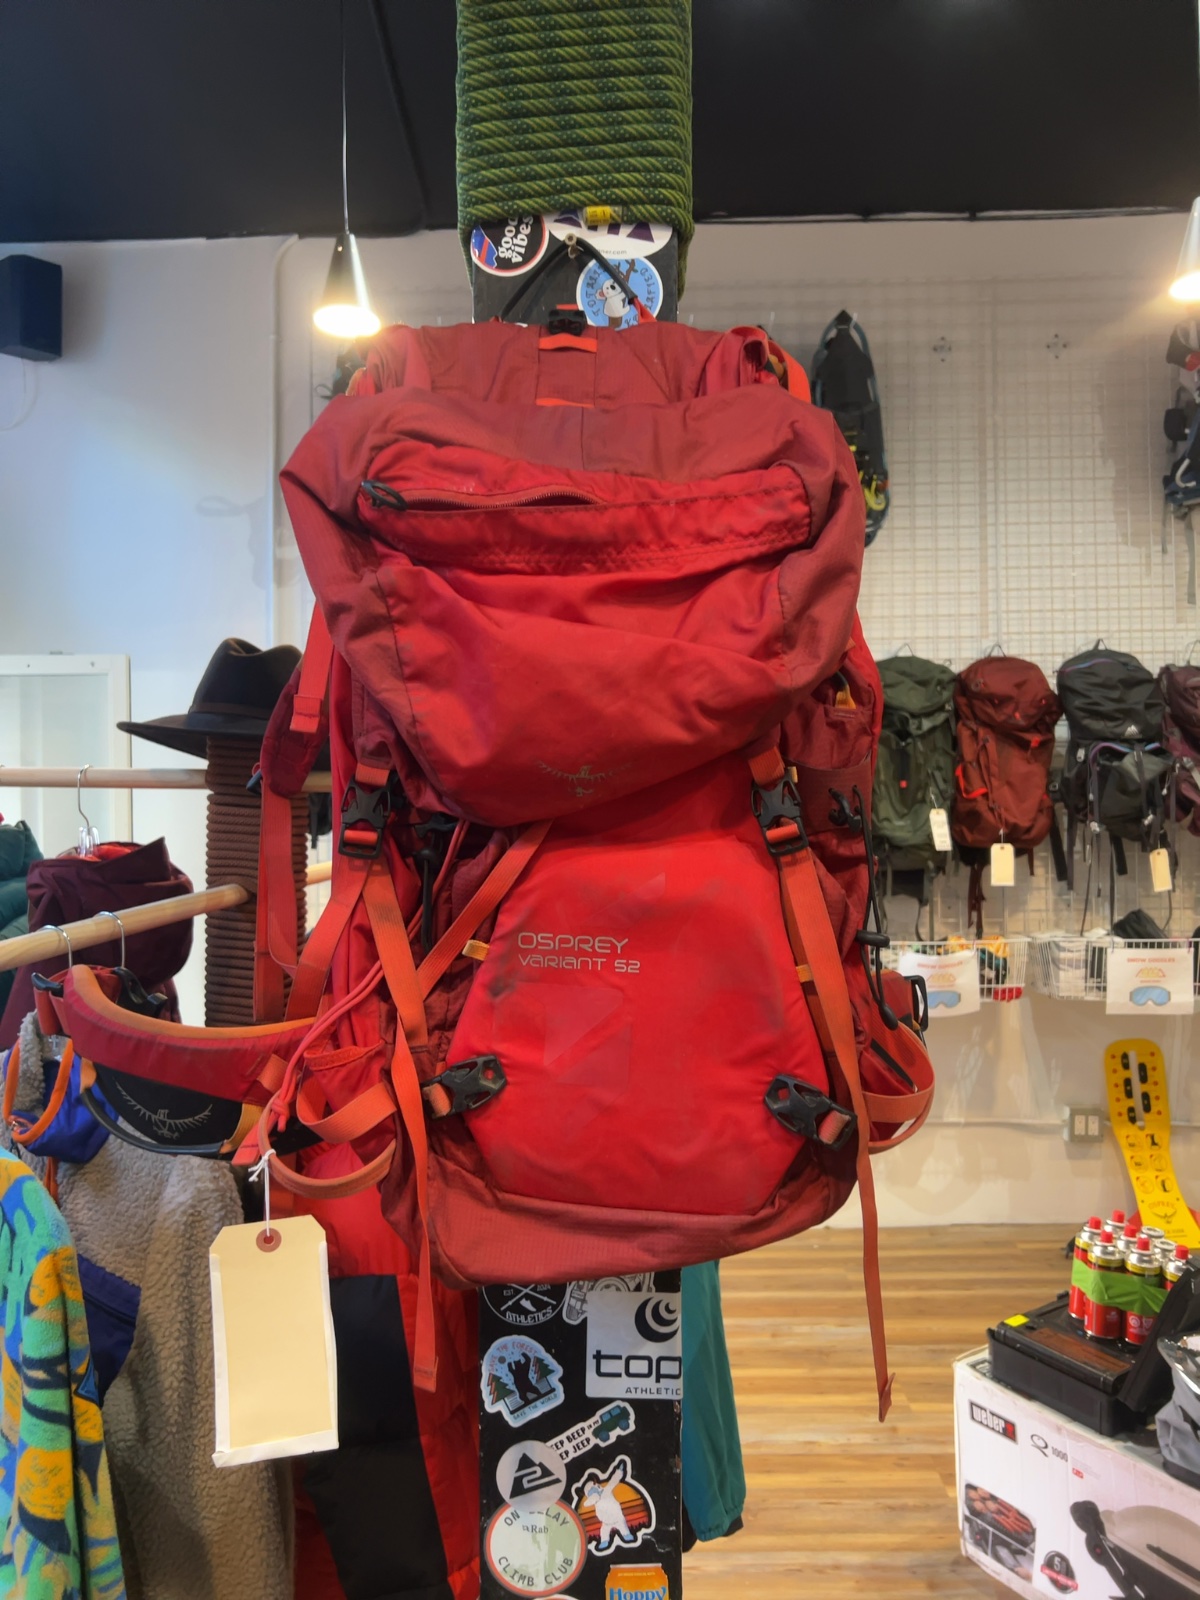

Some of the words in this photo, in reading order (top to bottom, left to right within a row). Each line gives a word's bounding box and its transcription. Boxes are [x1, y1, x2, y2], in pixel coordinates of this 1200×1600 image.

[518, 932, 628, 954] OSPREY
[506, 1306, 553, 1323] ATHLETICS
[972, 1405, 1005, 1434] weber
[566, 1427, 586, 1444] BEEP
[572, 1437, 591, 1454] JEEP
[504, 1510, 520, 1527] ON
[529, 1507, 570, 1527] LAY
[531, 1524, 549, 1534] Rab
[498, 1556, 534, 1587] CLIMB
[544, 1557, 573, 1585] CLUB
